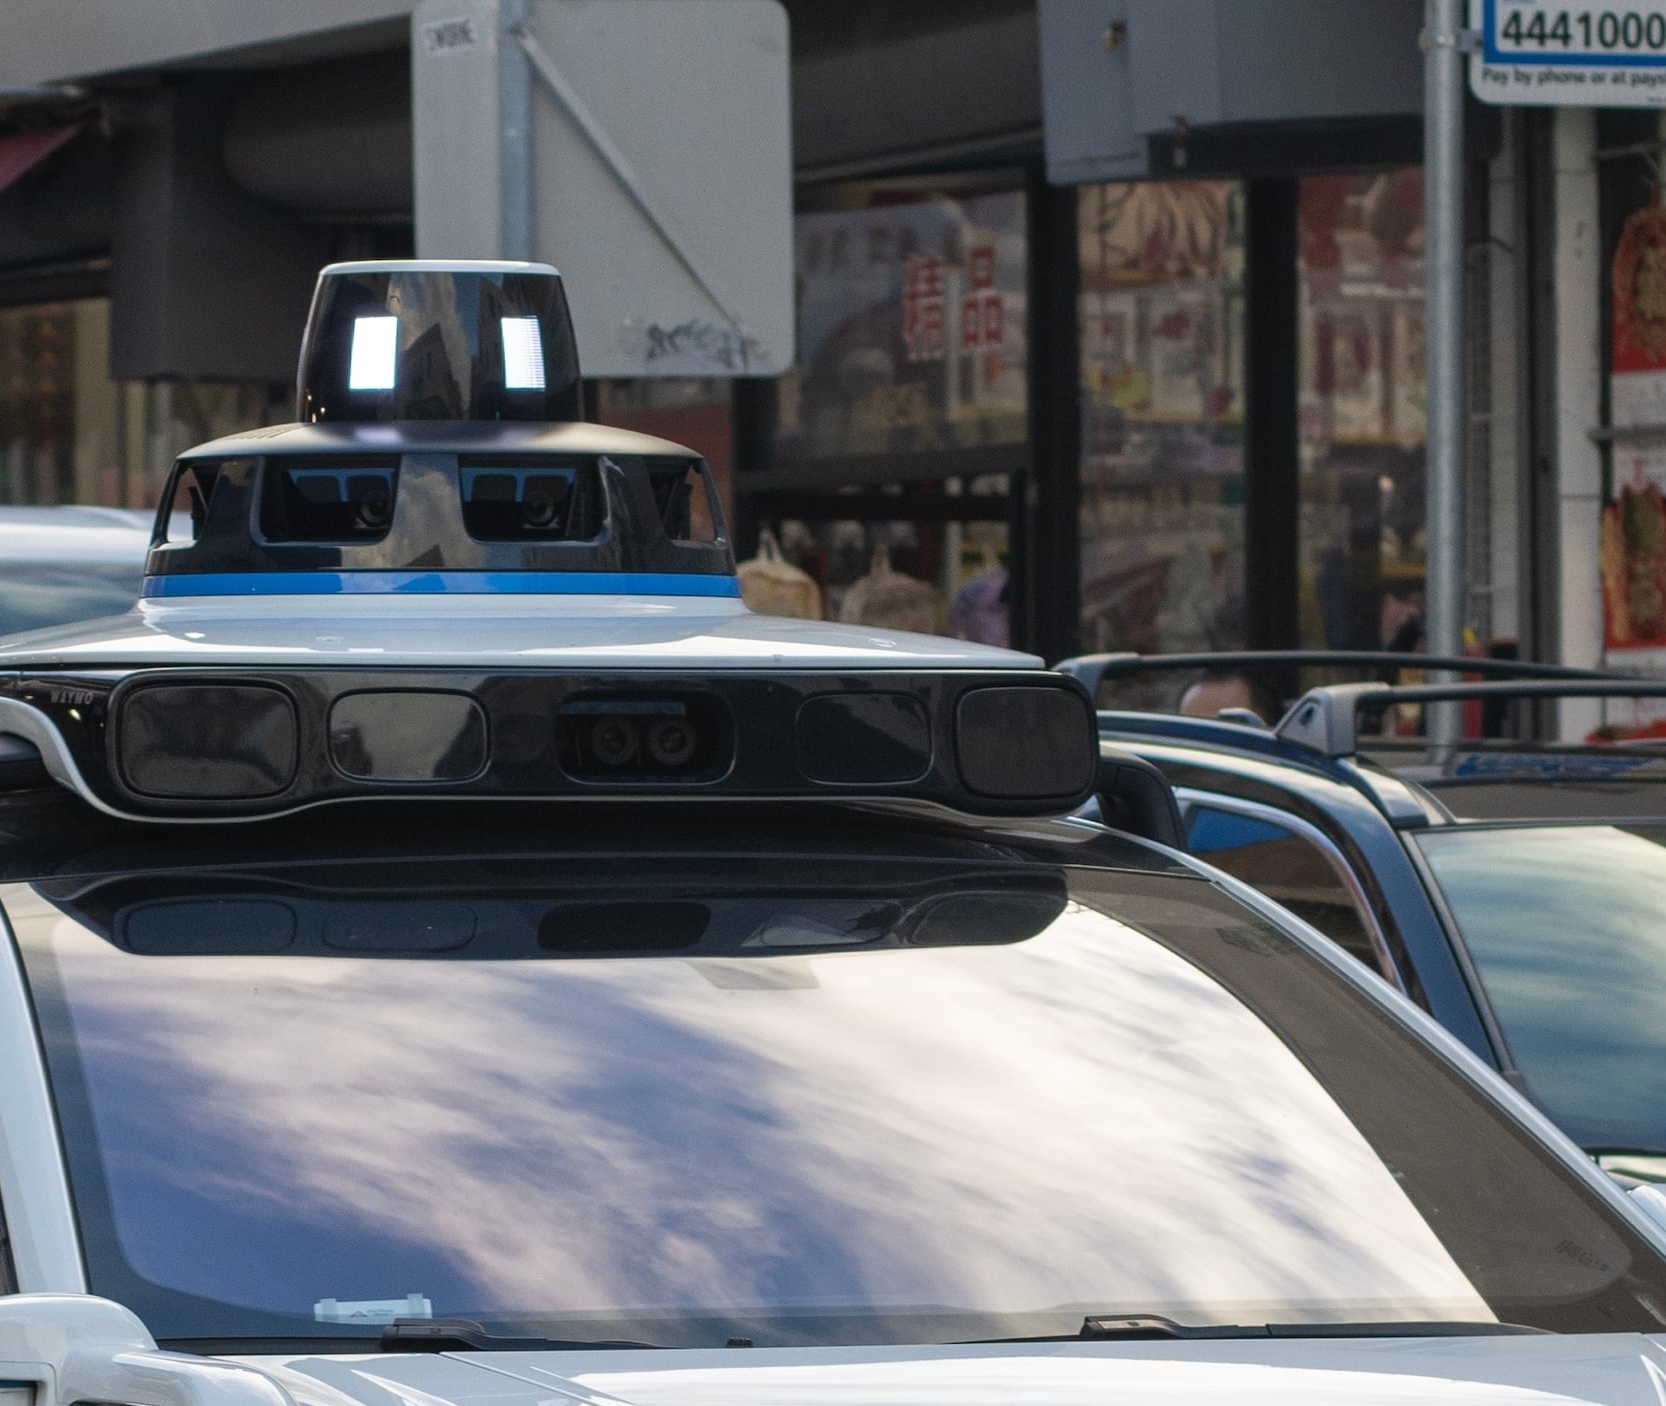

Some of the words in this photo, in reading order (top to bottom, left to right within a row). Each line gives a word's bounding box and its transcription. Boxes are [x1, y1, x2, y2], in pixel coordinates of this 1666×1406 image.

[1482, 67, 1508, 86] Pay
[1514, 67, 1531, 86] by
[1538, 69, 1586, 86] phone
[1591, 72, 1606, 83] or
[1611, 70, 1627, 84] at
[51, 690, 94, 705] WAYMO
